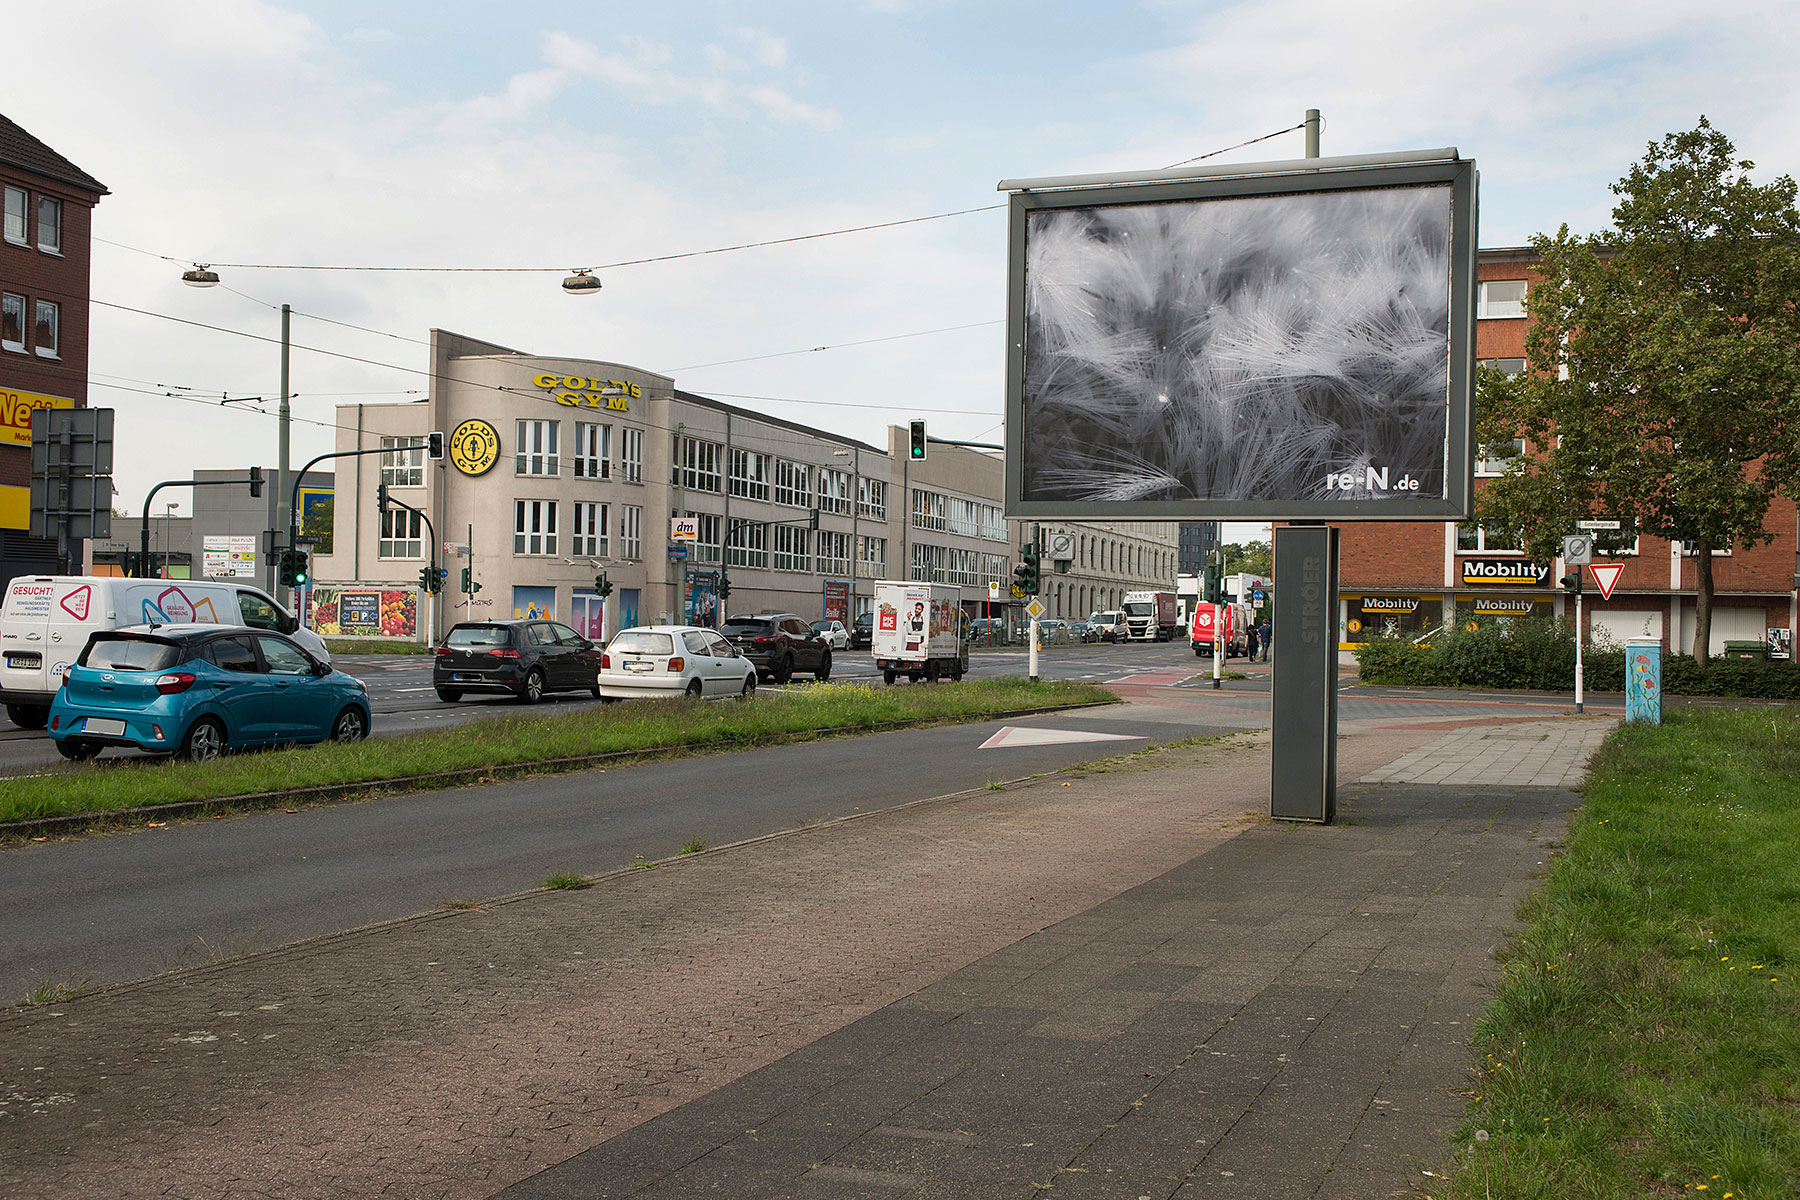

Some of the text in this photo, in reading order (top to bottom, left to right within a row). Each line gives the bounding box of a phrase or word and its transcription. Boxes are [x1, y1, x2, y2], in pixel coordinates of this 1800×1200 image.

[533, 374, 641, 398] GOLD'S
[556, 392, 629, 411] GYM
[454, 424, 494, 448] GOLD'S
[457, 455, 491, 471] GYM
[677, 521, 694, 532] dm
[1463, 562, 1549, 580] Mobility
[13, 586, 54, 596] GESUCHT!
[1302, 556, 1320, 644] STRÖER
[1363, 598, 1420, 611] Mobility
[1475, 599, 1534, 613] Mobility
